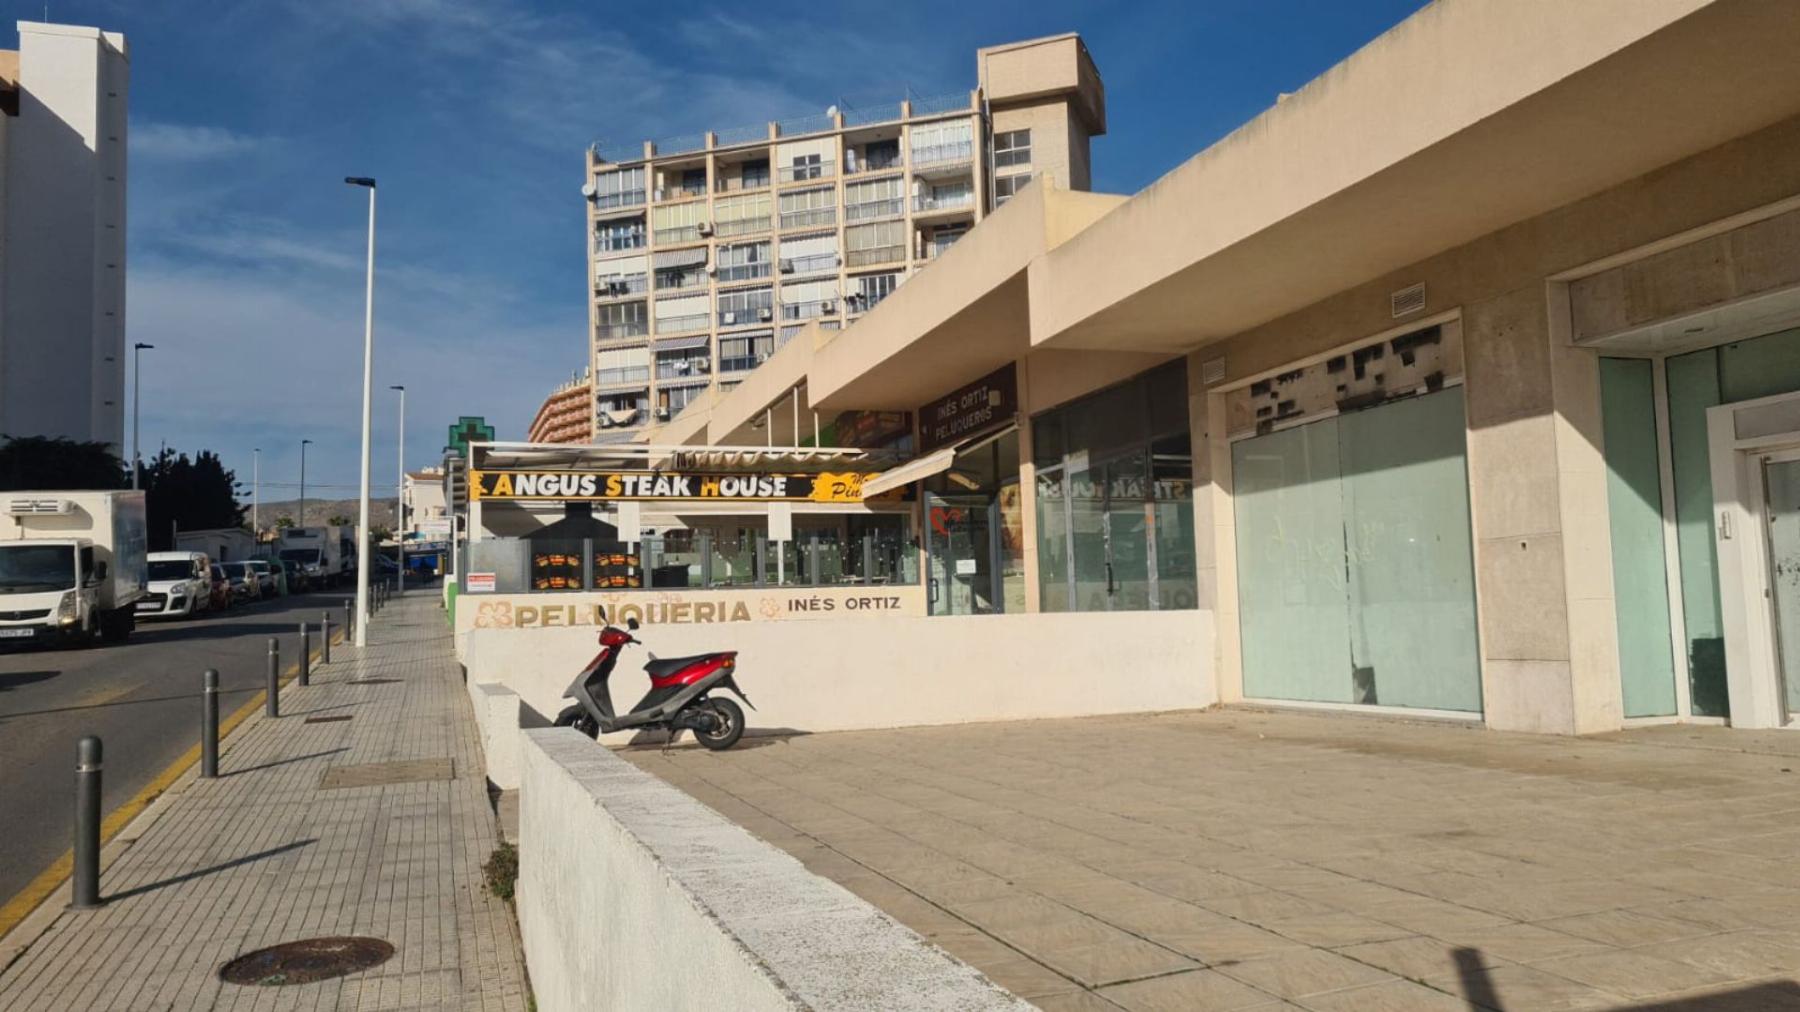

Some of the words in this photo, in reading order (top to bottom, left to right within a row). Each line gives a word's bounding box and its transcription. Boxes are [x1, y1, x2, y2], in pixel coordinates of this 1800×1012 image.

[960, 385, 989, 410] ORTIZ
[935, 405, 993, 442] PELUQUEROS
[492, 474, 596, 496] ANGUS
[605, 474, 692, 496] STEAK
[700, 475, 787, 497] HOUSE
[788, 595, 836, 611] INÉS
[845, 597, 901, 610] ORTIZ
